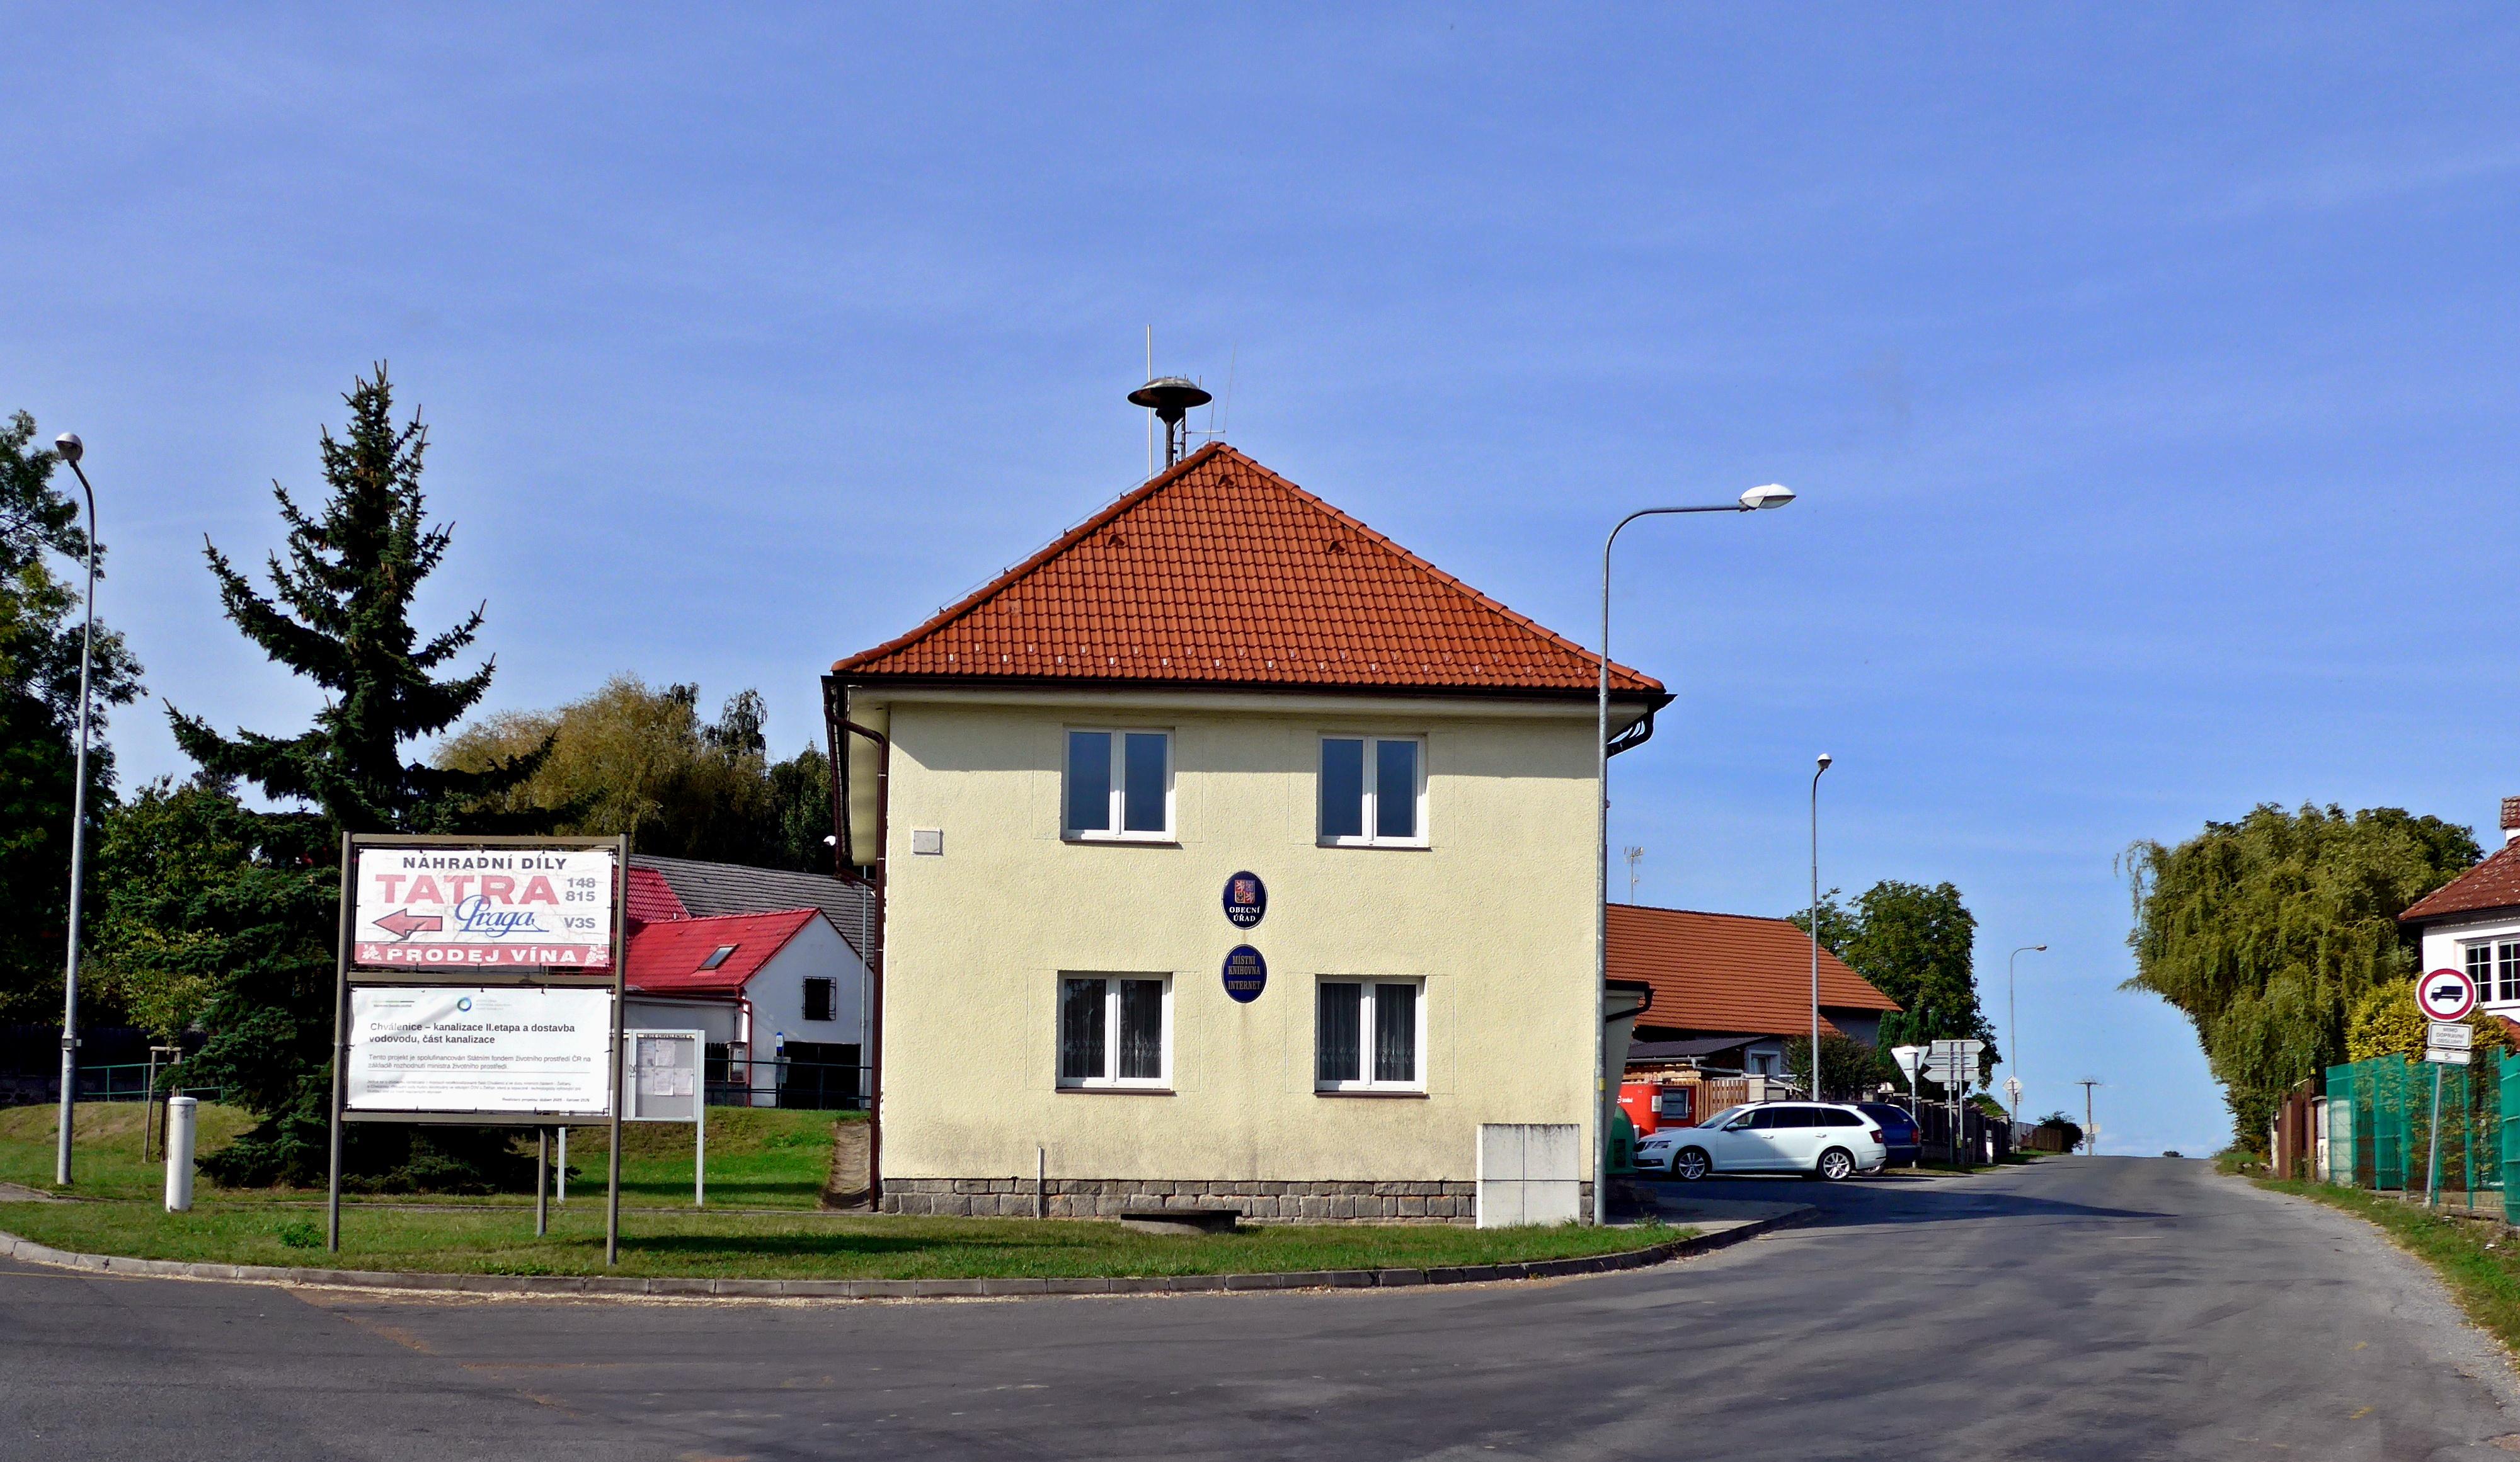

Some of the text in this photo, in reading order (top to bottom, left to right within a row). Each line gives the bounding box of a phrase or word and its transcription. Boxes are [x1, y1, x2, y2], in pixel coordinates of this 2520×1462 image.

[403, 854, 567, 870] NÁHRADNÍ DÍLY
[567, 877, 595, 888] 148
[375, 874, 559, 905] TATRA
[565, 891, 595, 901] 815
[455, 894, 595, 937] Praga V3S
[387, 945, 577, 962] PRODEJ VÍNA
[1232, 954, 1256, 964] MÍSTNÍ
[1228, 966, 1261, 975] KNIHOVNA
[1228, 980, 1261, 990] INTERNET
[434, 1023, 483, 1032] kanalizace
[486, 1024, 520, 1033] II.etapa
[531, 1024, 575, 1032] dostavba
[369, 1035, 495, 1044] vodovodu, část kanalizace
[387, 1054, 408, 1062] projekt
[572, 1054, 581, 1062] ČR
